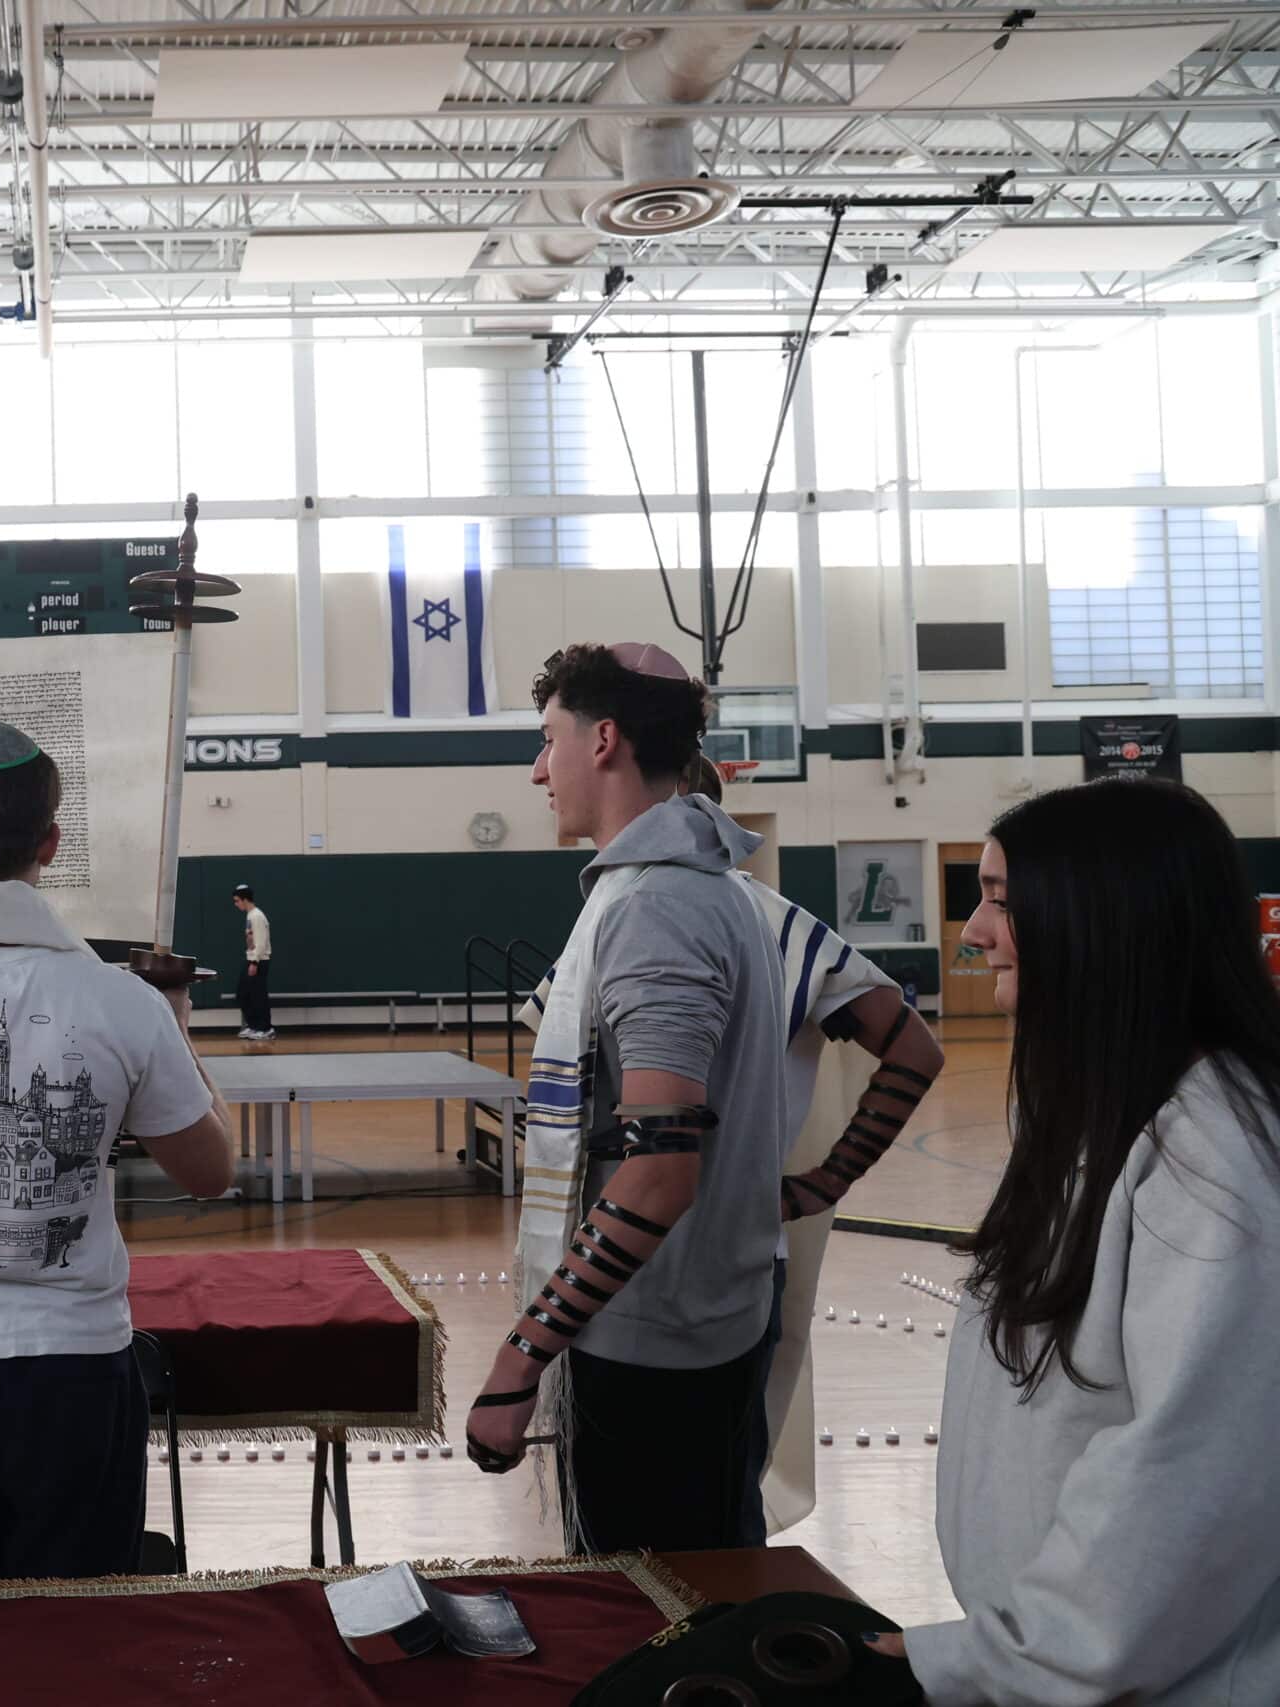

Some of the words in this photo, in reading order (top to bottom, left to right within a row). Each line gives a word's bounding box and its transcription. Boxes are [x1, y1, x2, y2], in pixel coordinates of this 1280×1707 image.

[126, 542, 166, 557] Guests
[41, 593, 79, 608] period
[41, 618, 80, 633] player
[184, 738, 283, 764] IONS
